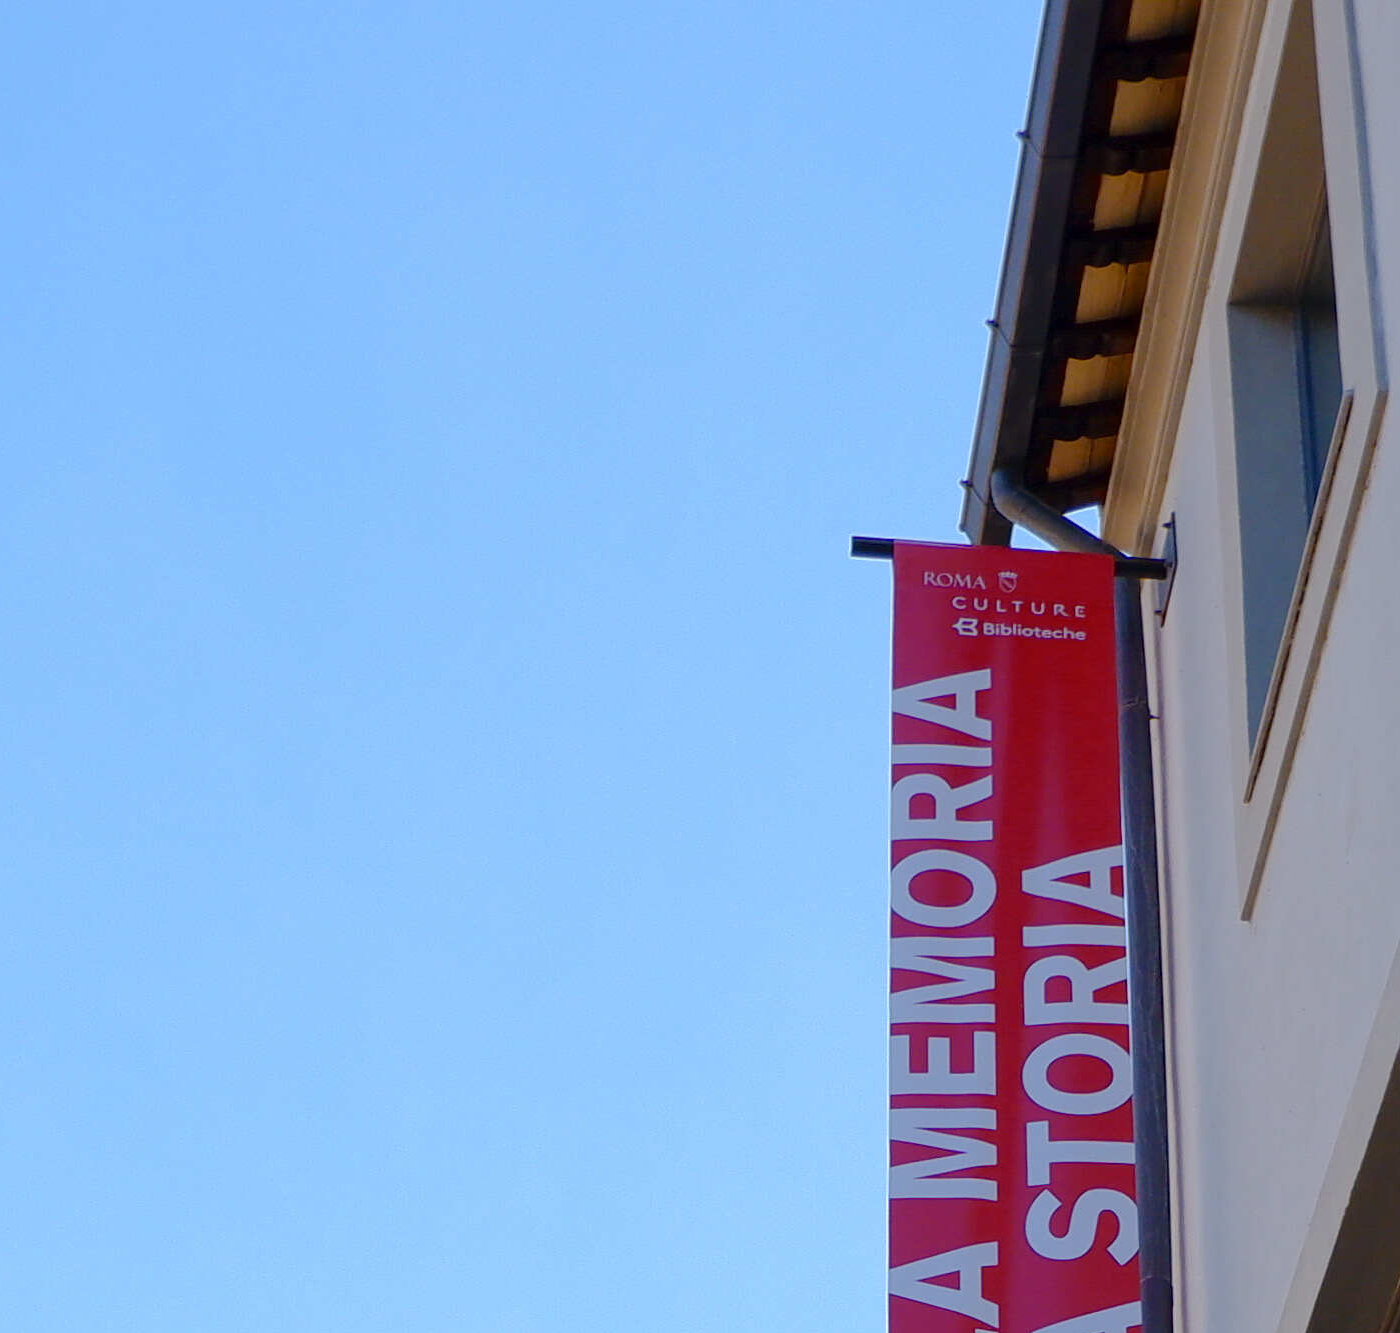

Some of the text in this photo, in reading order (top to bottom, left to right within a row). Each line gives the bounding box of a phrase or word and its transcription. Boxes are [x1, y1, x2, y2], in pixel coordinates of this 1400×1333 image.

[923, 571, 987, 590] ROMA
[952, 596, 1087, 618] CULTURE
[983, 622, 1087, 641] Biblioteche
[889, 668, 998, 1201] MEMORIA
[1022, 844, 1141, 1266] STORIA
